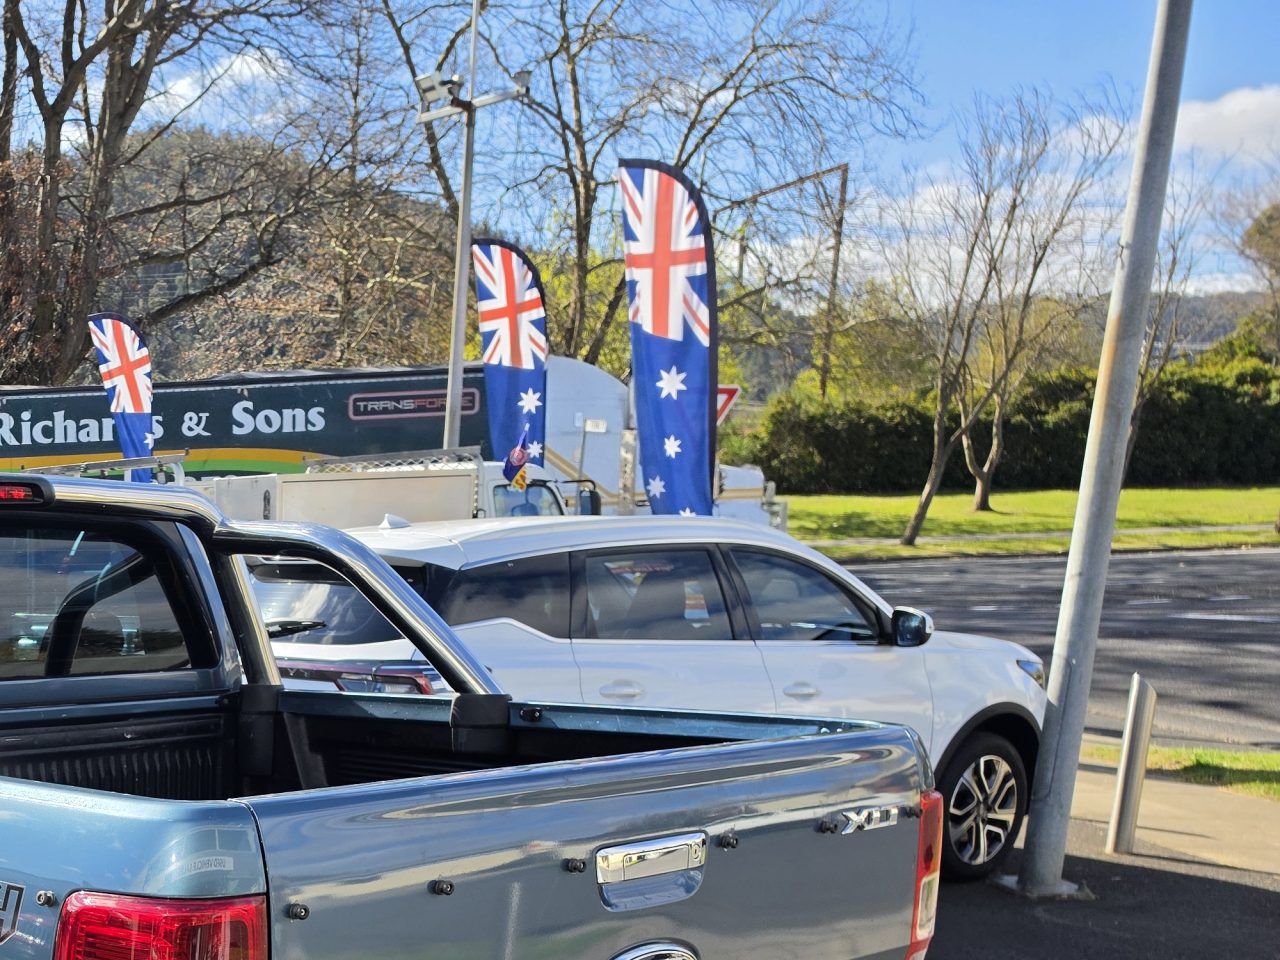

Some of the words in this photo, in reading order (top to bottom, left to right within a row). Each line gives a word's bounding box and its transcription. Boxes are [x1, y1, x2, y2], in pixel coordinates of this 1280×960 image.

[356, 396, 473, 412] TRANSFORE
[181, 411, 212, 437] &
[231, 400, 326, 435] Sons
[841, 807, 899, 835] XLT
